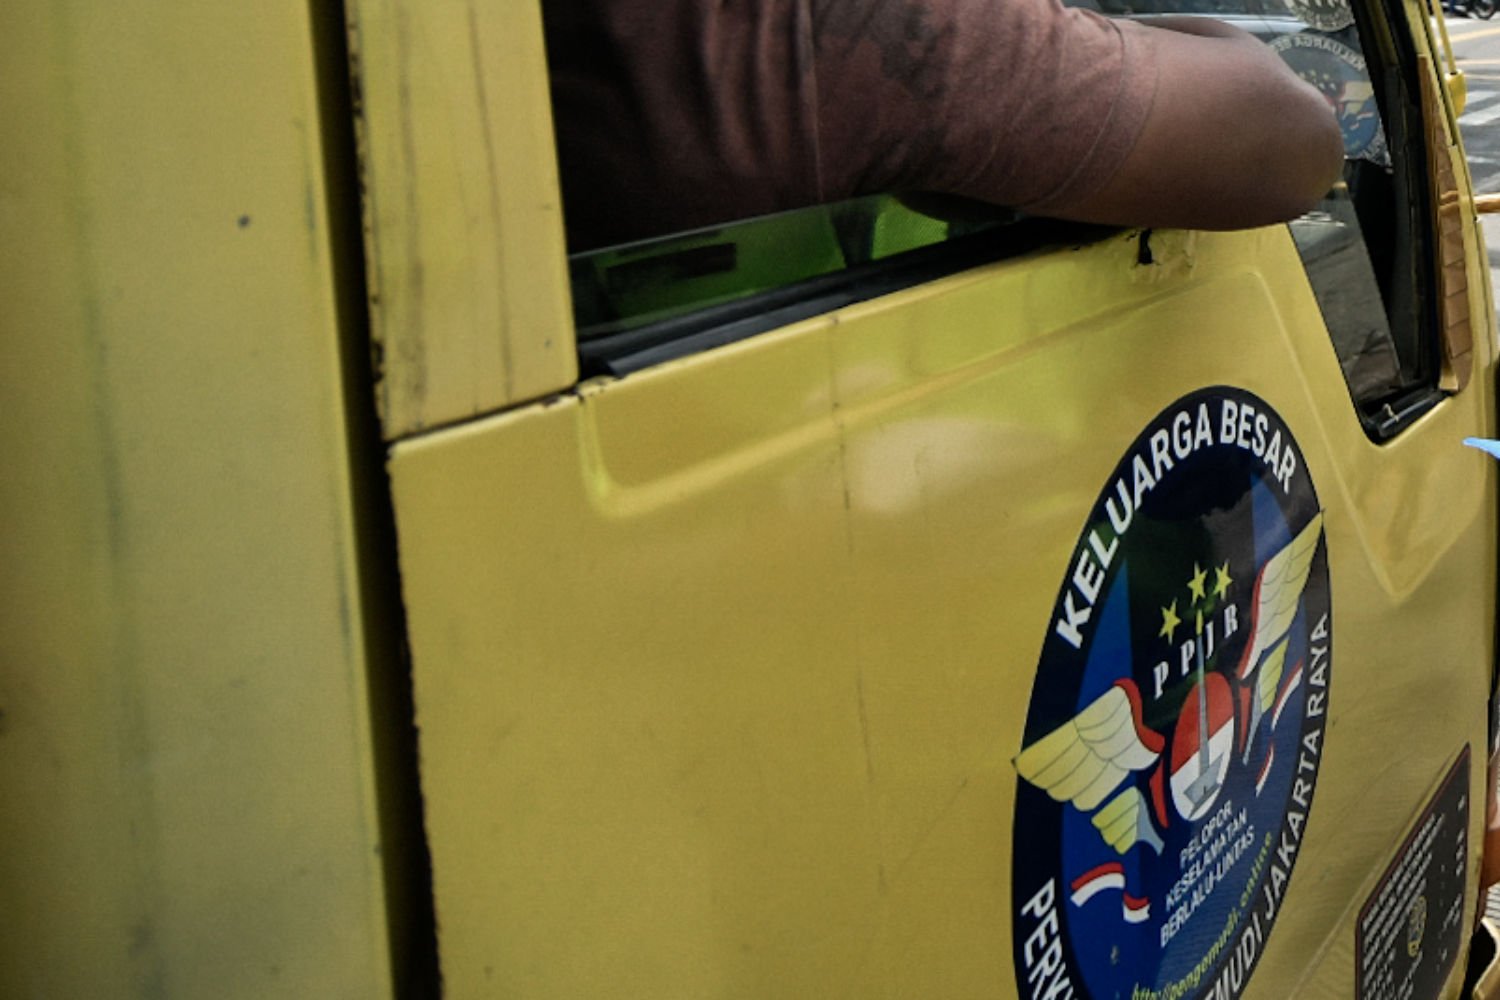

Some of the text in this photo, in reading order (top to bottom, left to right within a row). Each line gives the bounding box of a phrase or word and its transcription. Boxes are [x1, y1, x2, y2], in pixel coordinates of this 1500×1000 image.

[1056, 399, 1296, 649] KELUARGA BESAR
[1166, 808, 1248, 913] KESELAMATAN
[1263, 729, 1321, 921] JAKARTA
[1305, 612, 1330, 721] RAYA
